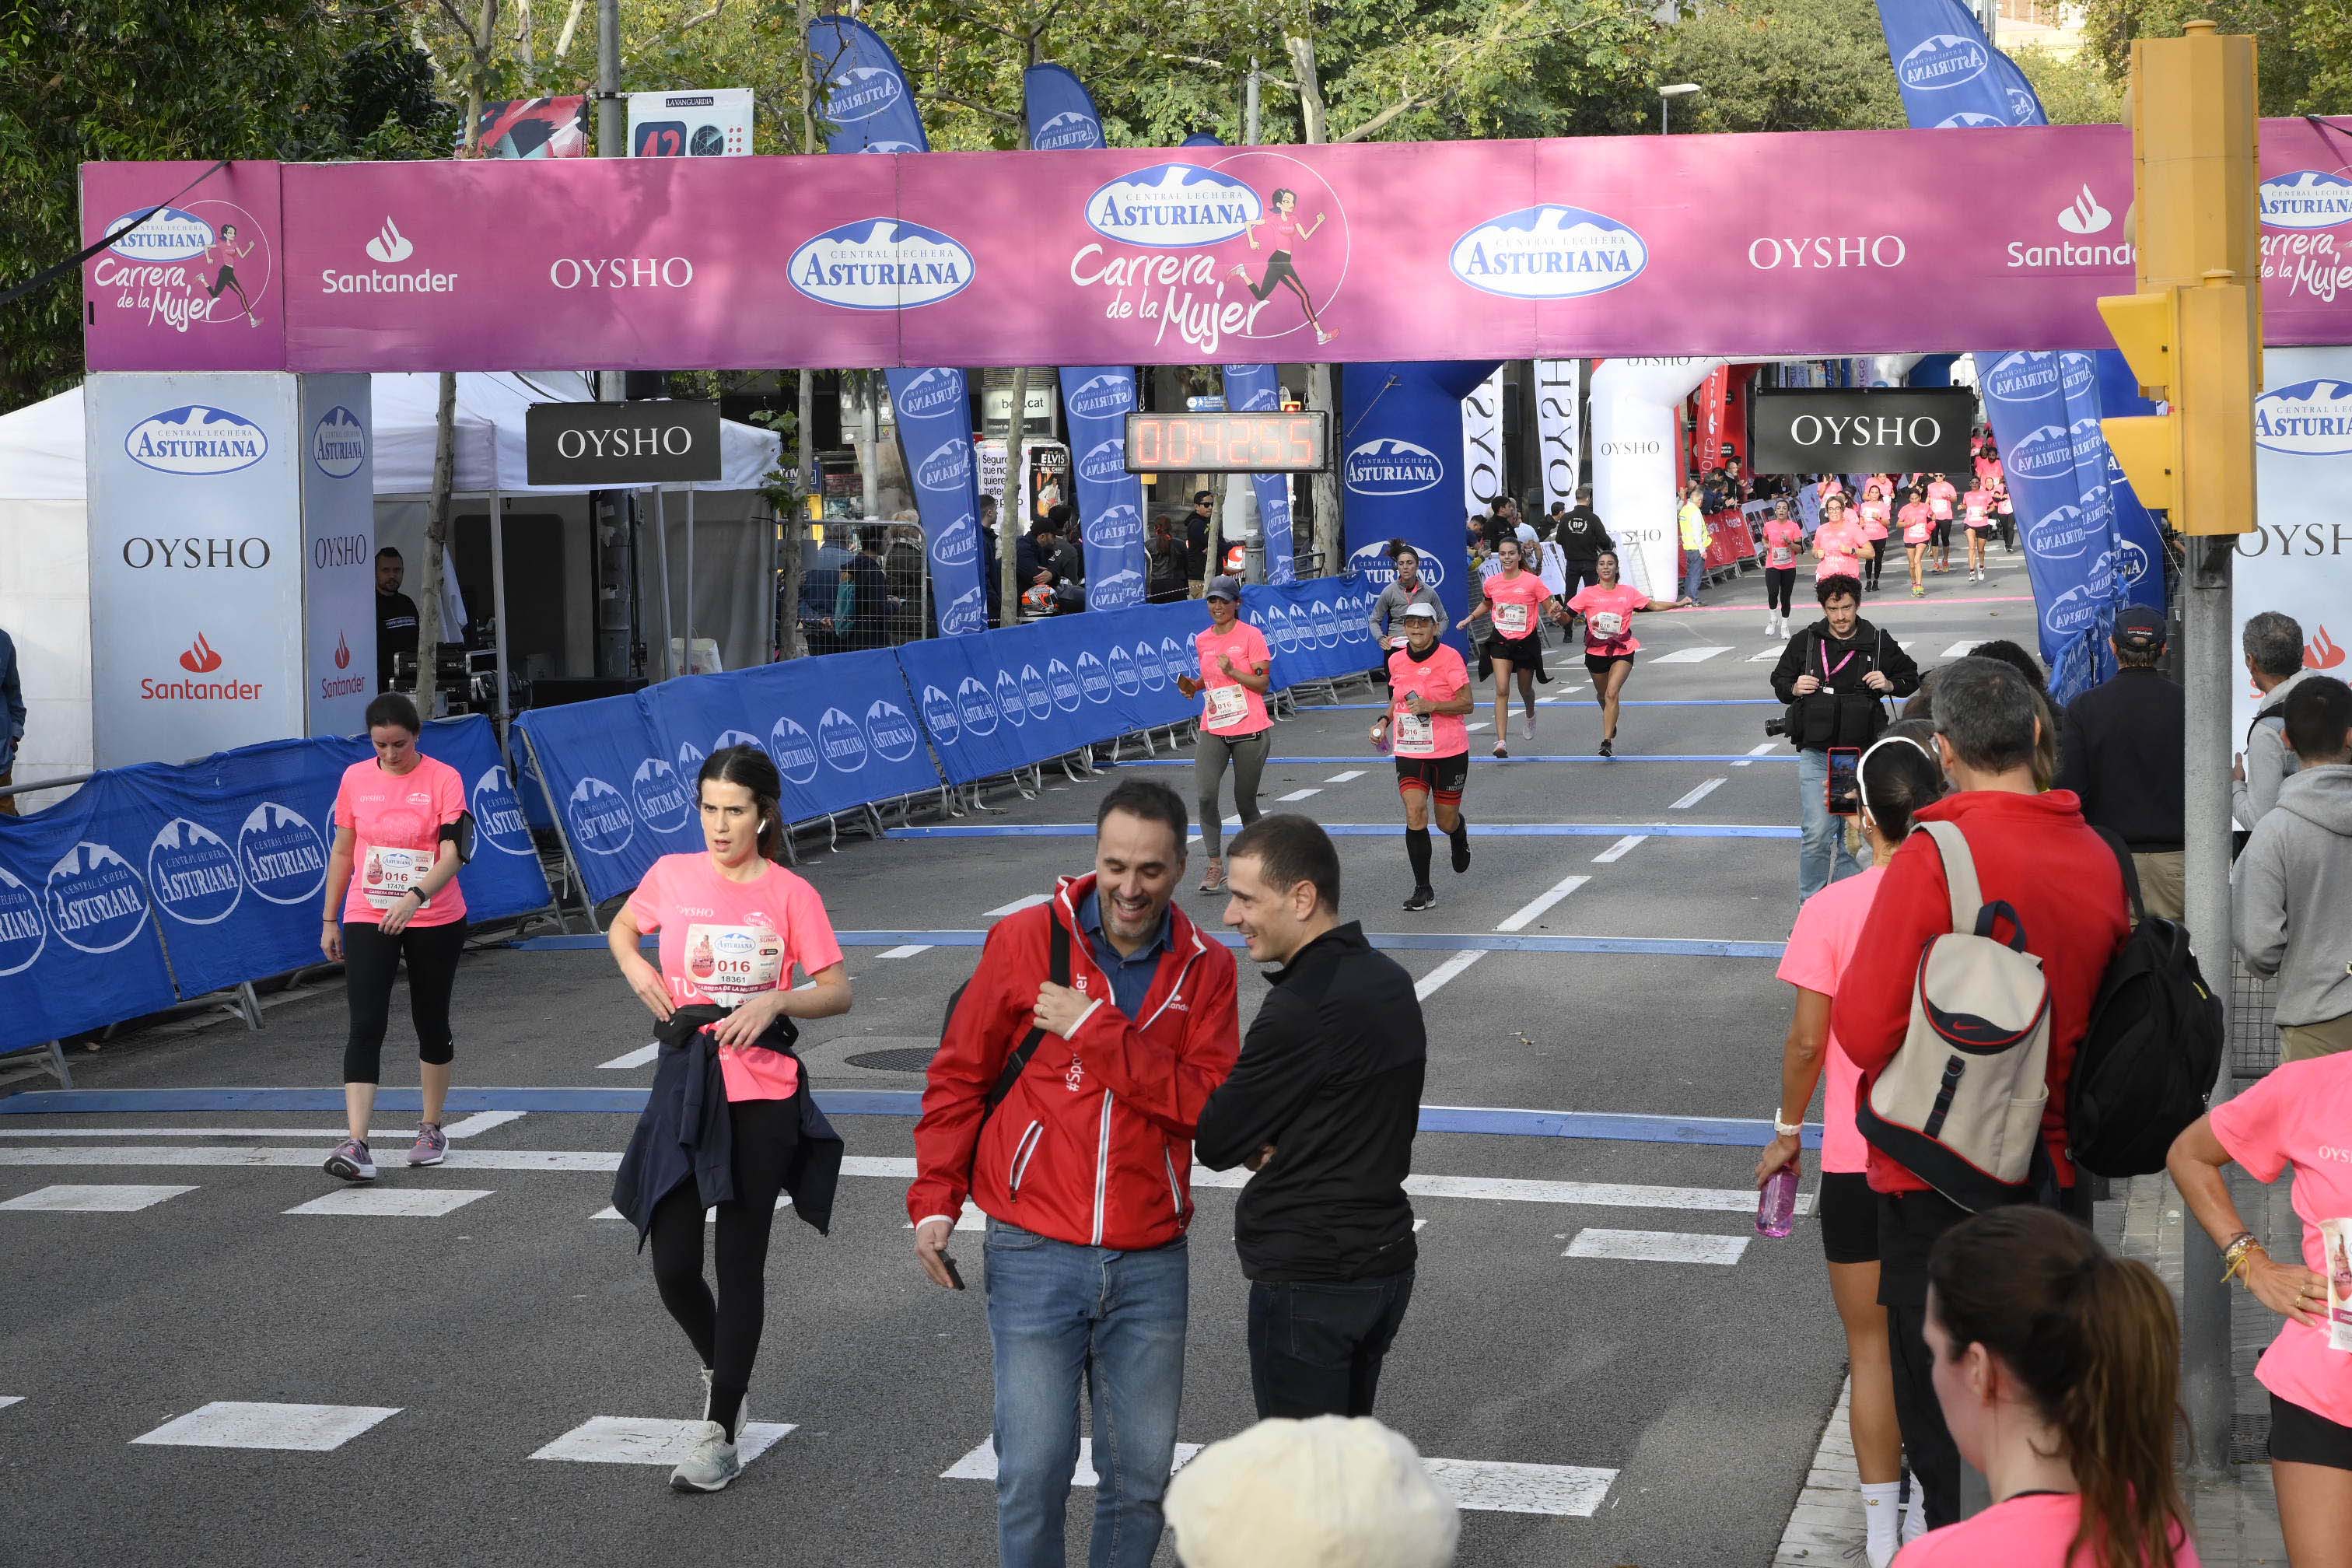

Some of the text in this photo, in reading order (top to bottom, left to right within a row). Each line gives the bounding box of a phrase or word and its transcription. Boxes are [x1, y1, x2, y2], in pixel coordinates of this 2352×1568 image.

[1126, 191, 1244, 201] CENTRAL LECHERA
[1099, 194, 1246, 228] ASTURIANA
[112, 226, 206, 249] ASTURIANA
[1563, 236, 1627, 247] LECHERA
[2260, 234, 2334, 257] arrera
[830, 248, 954, 259] CENTRAL LECHERA
[1070, 243, 1216, 288] Carrera
[1465, 241, 1633, 276] ASTURIANA
[1748, 235, 1906, 270] OYSHO
[2007, 241, 2137, 268] Santand
[94, 257, 187, 289] Carrera
[322, 269, 458, 294] Santander
[550, 257, 694, 289] OYSHO
[801, 252, 961, 287] ASTURIANA
[2289, 252, 2352, 304] Muje
[117, 284, 221, 333] de la Mujer
[1106, 282, 1271, 354] de la Mujer
[1002, 398, 1044, 409] bc.cat
[2277, 405, 2331, 414] CENTRAL
[1790, 415, 1941, 446] OYSHO
[2256, 408, 2352, 437] ASTURI
[136, 431, 258, 458] ASTURIANA
[317, 433, 362, 460] ASTURIANA
[557, 425, 693, 459] OYSHO
[1601, 440, 1661, 456] OYSHO
[983, 467, 996, 476] que
[1041, 453, 1065, 464] ELVIS
[983, 476, 1008, 486] quiere
[1348, 464, 1436, 483] ASTURIANA
[123, 537, 271, 569] OYSHO
[315, 534, 367, 569] OYSHO
[2235, 523, 2352, 558] OYSH
[141, 678, 263, 700] Santander
[322, 673, 366, 700] Santander
[778, 744, 816, 770] ASTURIANA
[823, 733, 866, 759] ASTURIANA
[482, 802, 527, 836] ASTUR
[254, 831, 312, 852] CENTRAL LECHERA
[166, 849, 226, 870] CENTRAL LECHERA
[246, 844, 324, 884] ASTURIANA
[63, 880, 96, 895] CENTRAL
[159, 863, 238, 904] ASTURIANA
[385, 872, 408, 883] 016
[55, 884, 143, 933] ASTURIANA
[0, 908, 41, 943] RIANA
[720, 940, 753, 950] ASTURIANA
[717, 960, 751, 973] 016
[721, 975, 746, 984] 18361
[2319, 1146, 2352, 1164] OYS
